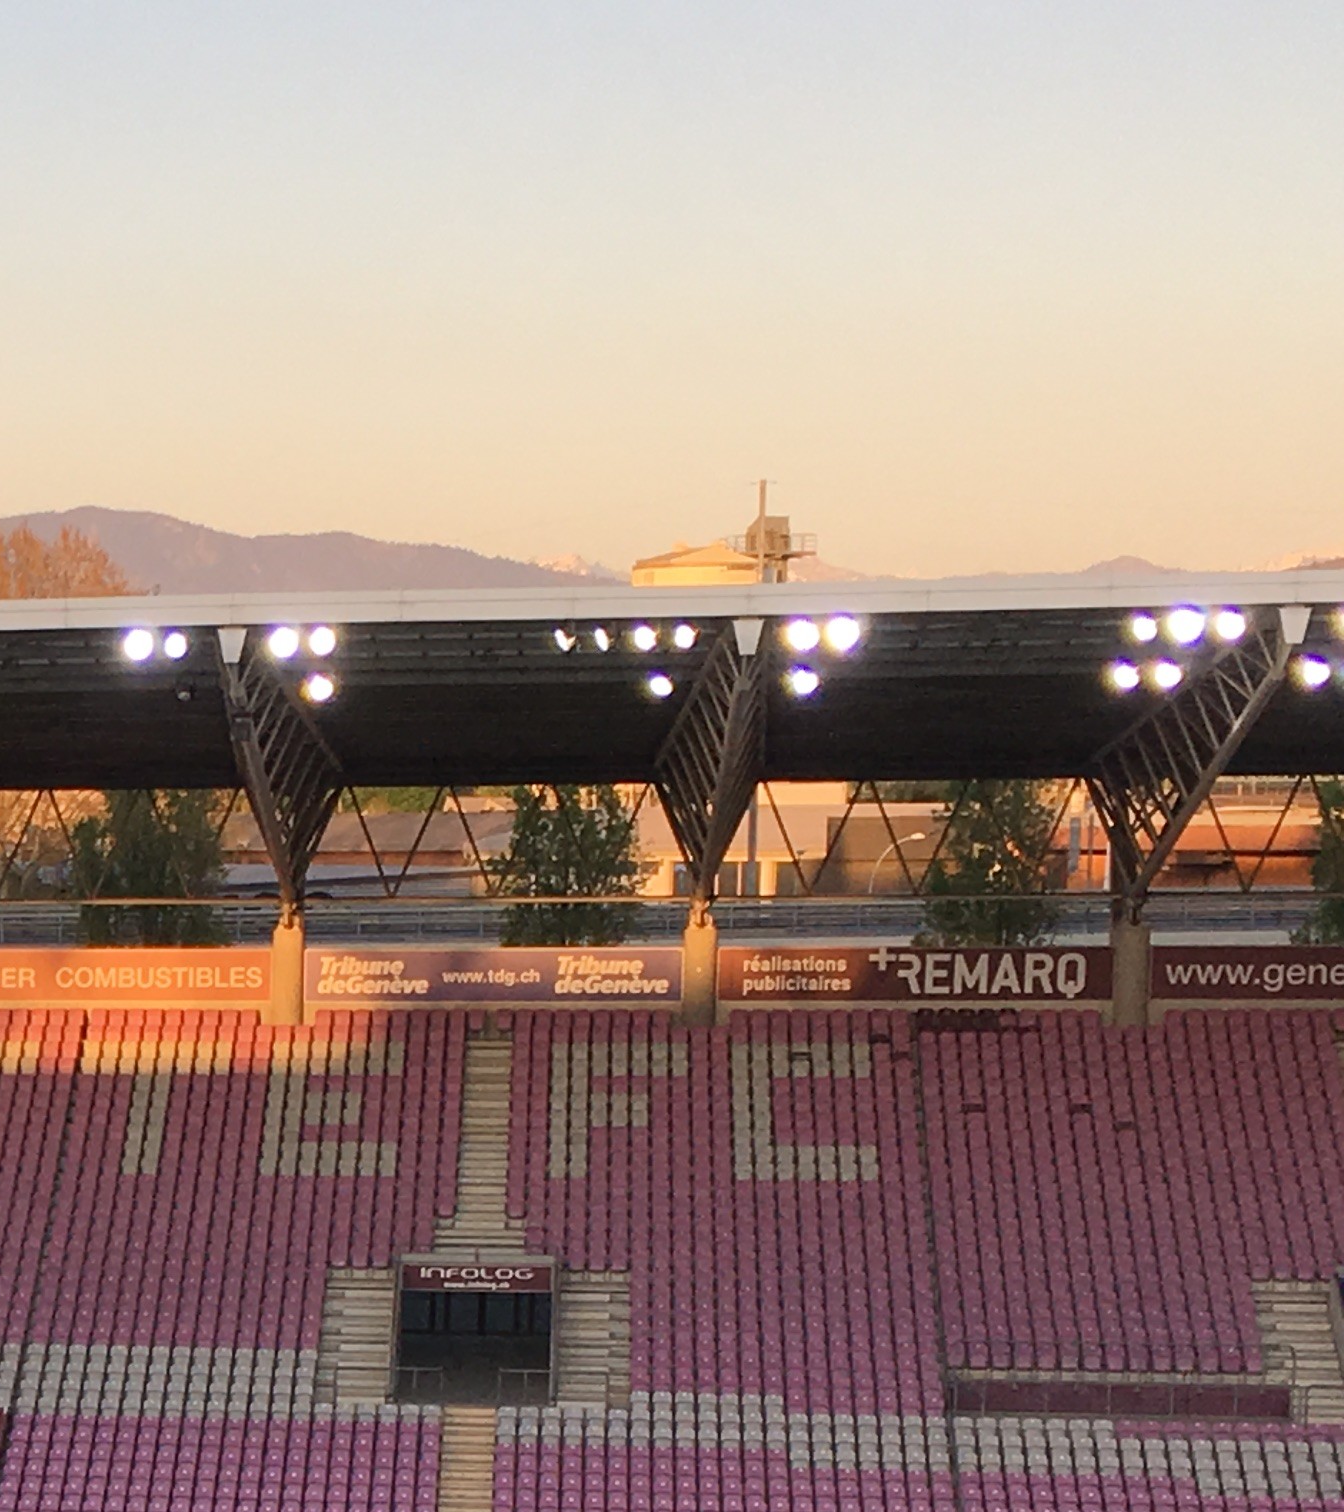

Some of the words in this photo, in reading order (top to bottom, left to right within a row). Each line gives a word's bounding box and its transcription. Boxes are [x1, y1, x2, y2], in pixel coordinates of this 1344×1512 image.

[319, 956, 404, 975] Tribune
[556, 956, 643, 975] Tribune
[742, 955, 847, 972] réalisations
[55, 966, 263, 989] COMBUSTIBLES
[317, 975, 429, 996] deGenève
[442, 968, 541, 987] www.tdg.ch
[554, 975, 669, 996] deGenève
[742, 975, 851, 995] publicitaires
[549, 1042, 878, 1181] FC
[420, 1267, 534, 1280] INFOLOG
